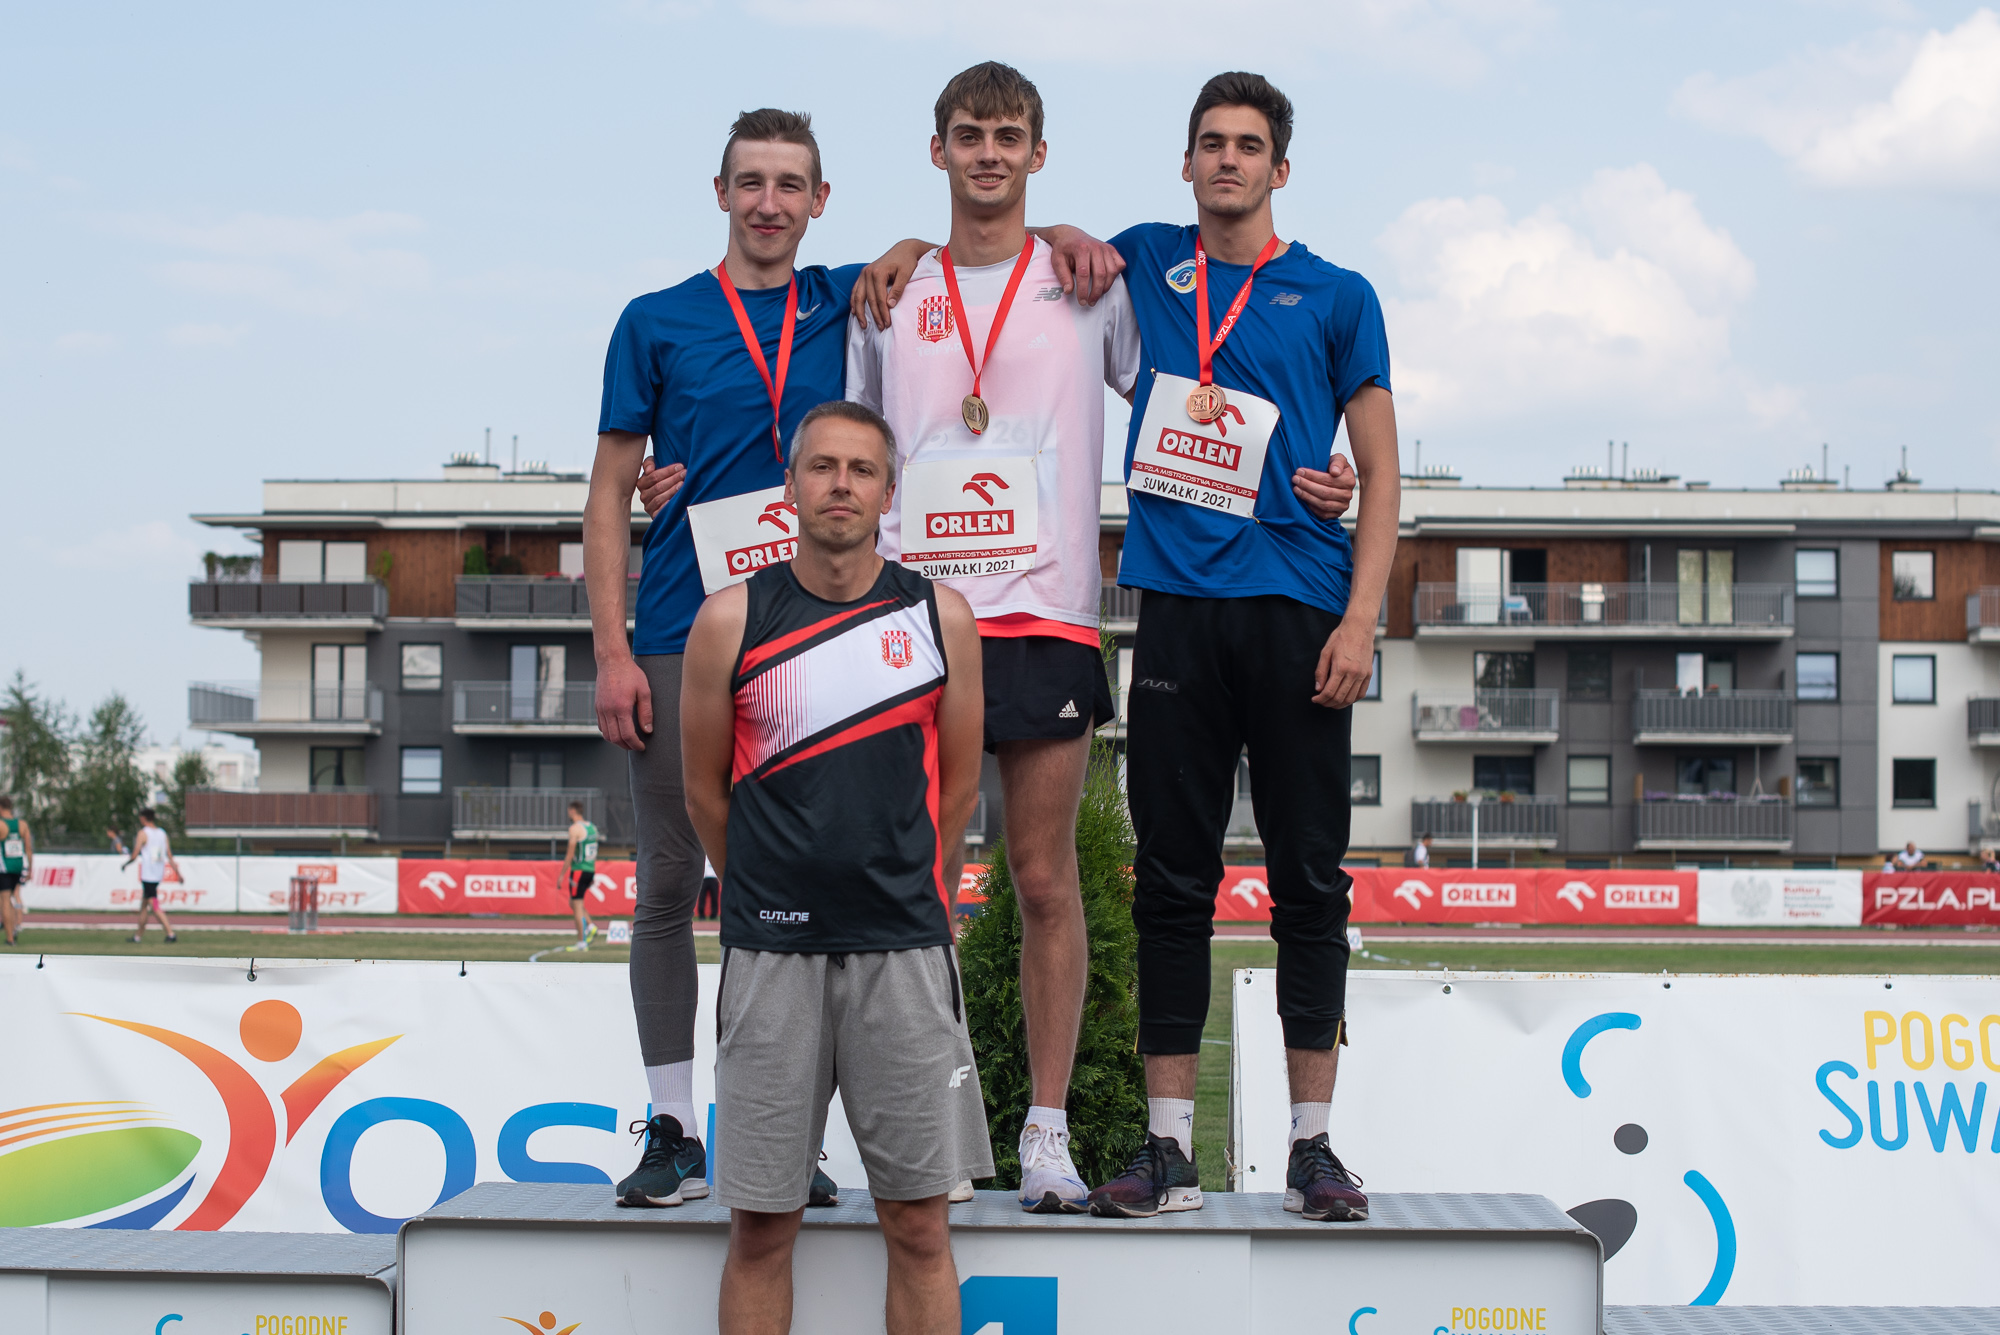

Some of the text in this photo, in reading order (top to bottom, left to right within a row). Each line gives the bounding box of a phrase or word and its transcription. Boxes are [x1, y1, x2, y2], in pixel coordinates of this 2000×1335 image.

[1215, 315, 1237, 342] PZLA
[1162, 432, 1236, 467] ORLEN
[1144, 465, 1160, 474] PZLA
[1159, 468, 1211, 486] MISTRZOSTWA
[1211, 481, 1237, 493] POLSKI
[1237, 487, 1253, 497] U23
[1142, 477, 1233, 509] SUWAŁKI 2021
[930, 513, 1009, 535] ORLEN
[938, 550, 991, 559] MISTRZOSTWA
[923, 559, 1015, 577] SUWAŁKI 2021
[470, 880, 530, 893] ORLEN
[1449, 888, 1511, 902] ORLEN
[1610, 889, 1673, 904] ORLEN
[268, 891, 367, 907] SORT
[759, 910, 810, 922] CUTLINE
[610, 927, 626, 939] 60
[948, 1064, 972, 1089] 4F
[1815, 1060, 2000, 1154] SUW
[255, 1314, 348, 1335] POGODNE
[1452, 1307, 1547, 1330] POGODNE
